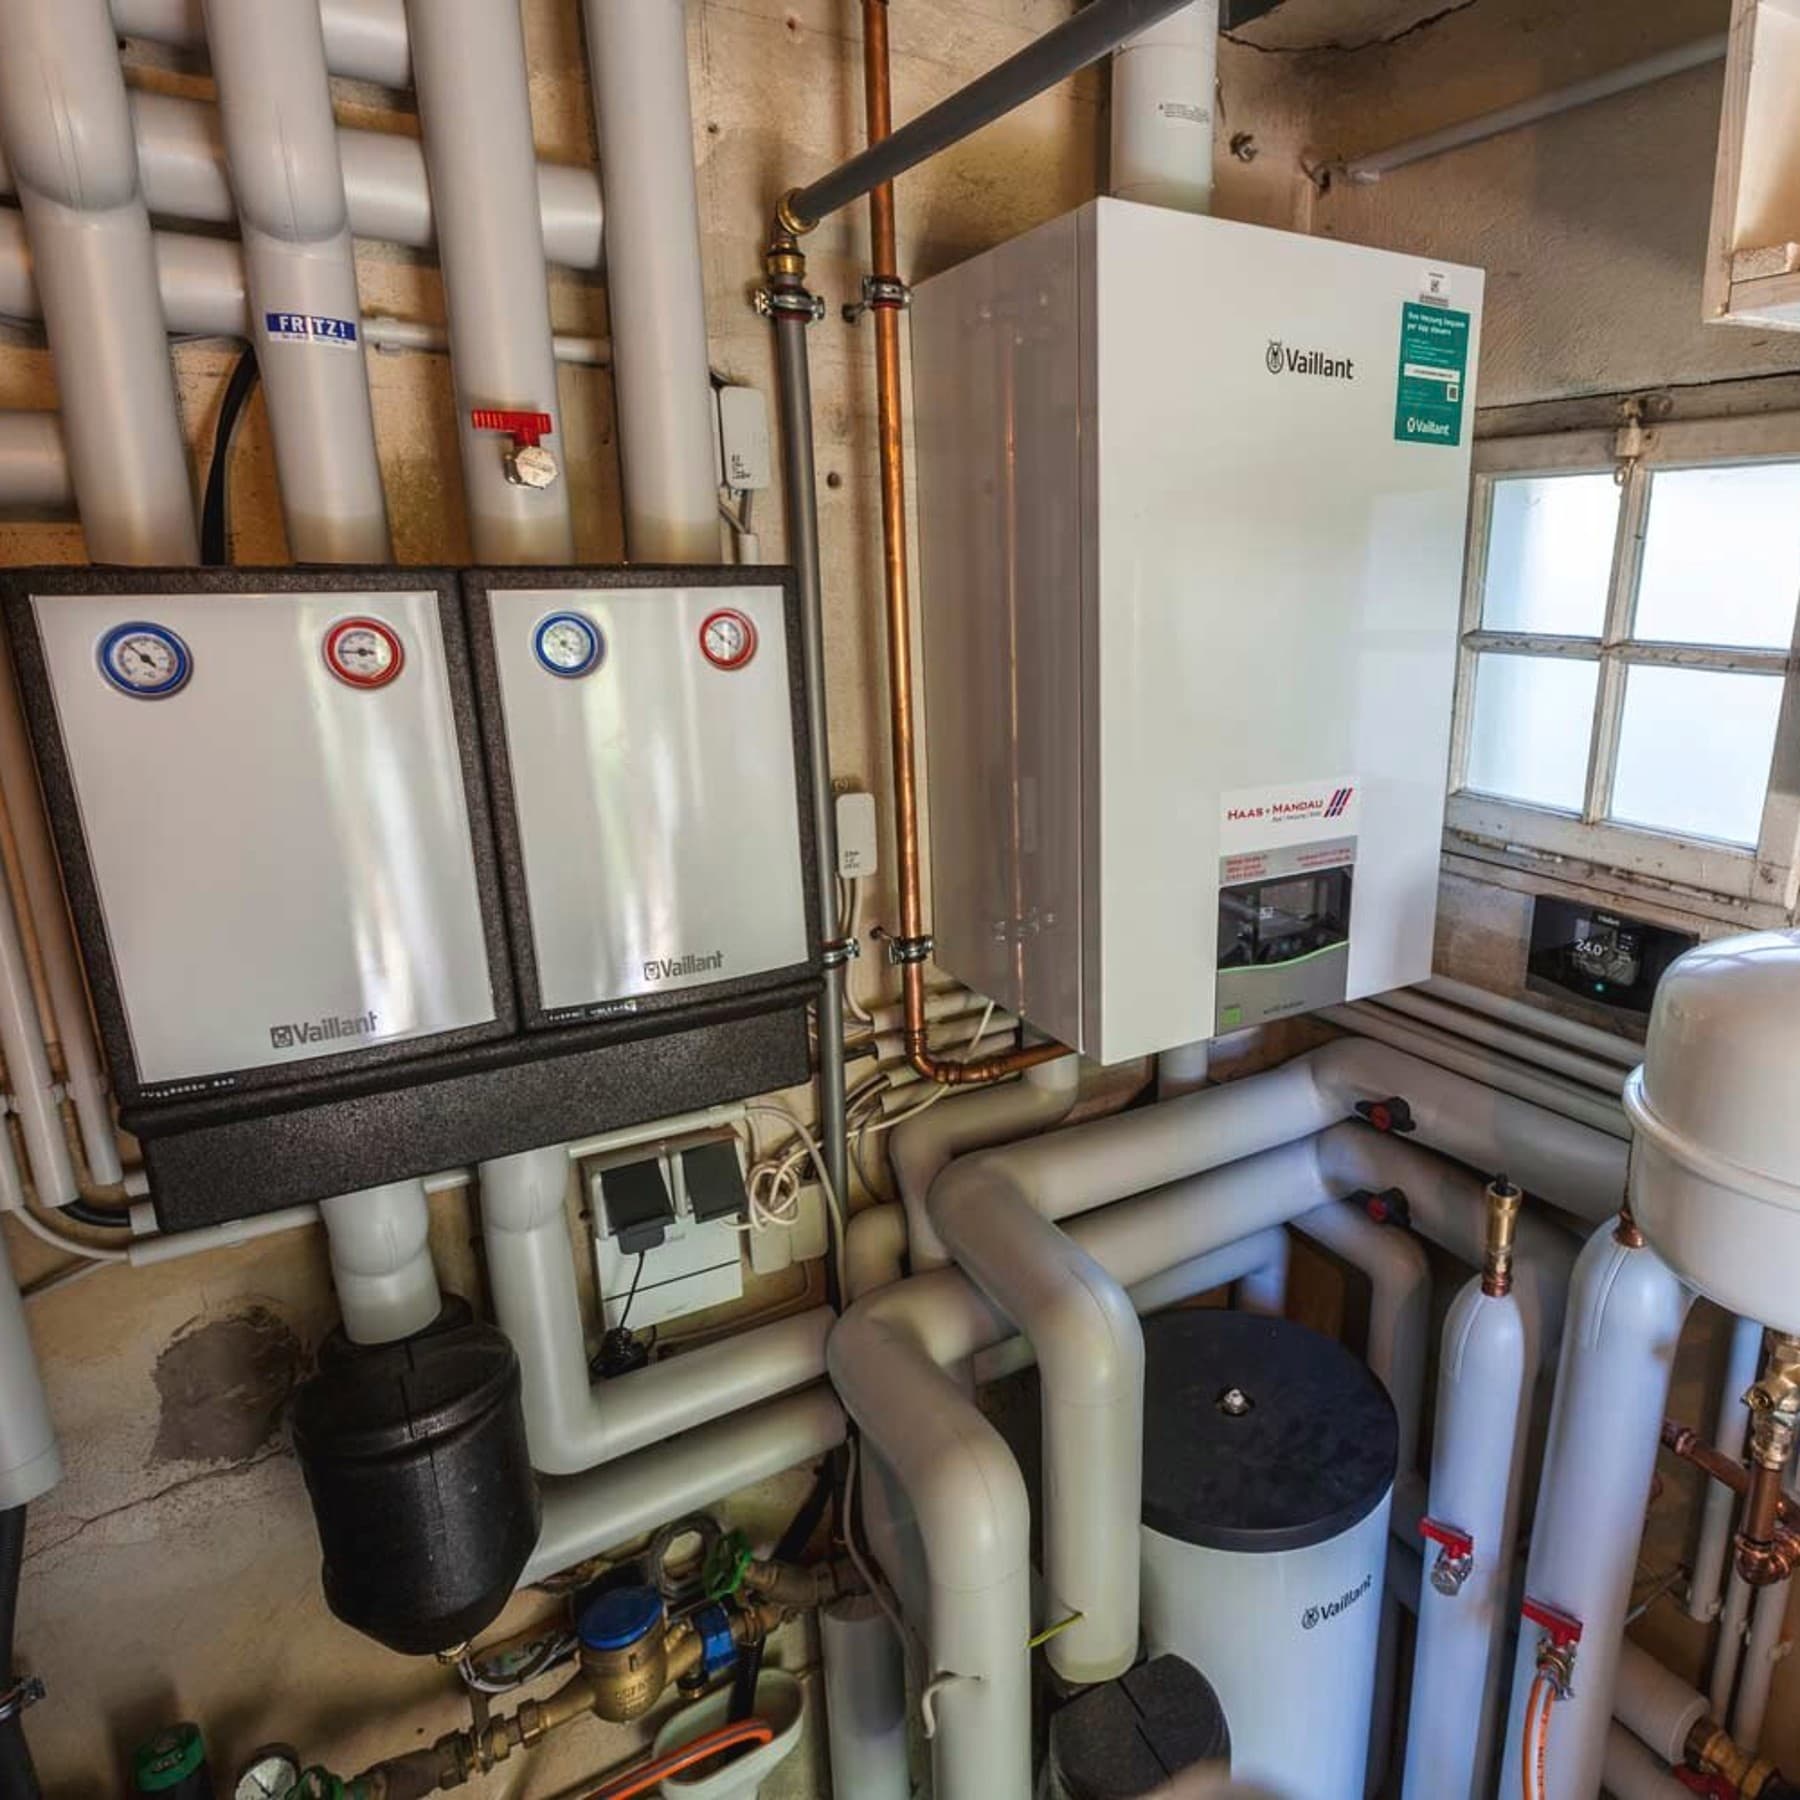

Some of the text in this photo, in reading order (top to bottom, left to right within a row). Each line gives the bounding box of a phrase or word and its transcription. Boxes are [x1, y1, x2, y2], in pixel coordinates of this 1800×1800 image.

[278, 315, 346, 338] FRITZ!
[1286, 347, 1355, 380] Vaillant
[1416, 418, 1450, 436] Vaillant
[659, 949, 724, 978] Vaillant
[292, 1010, 379, 1045] Vaillant
[1320, 1573, 1372, 1620] Vaillant
